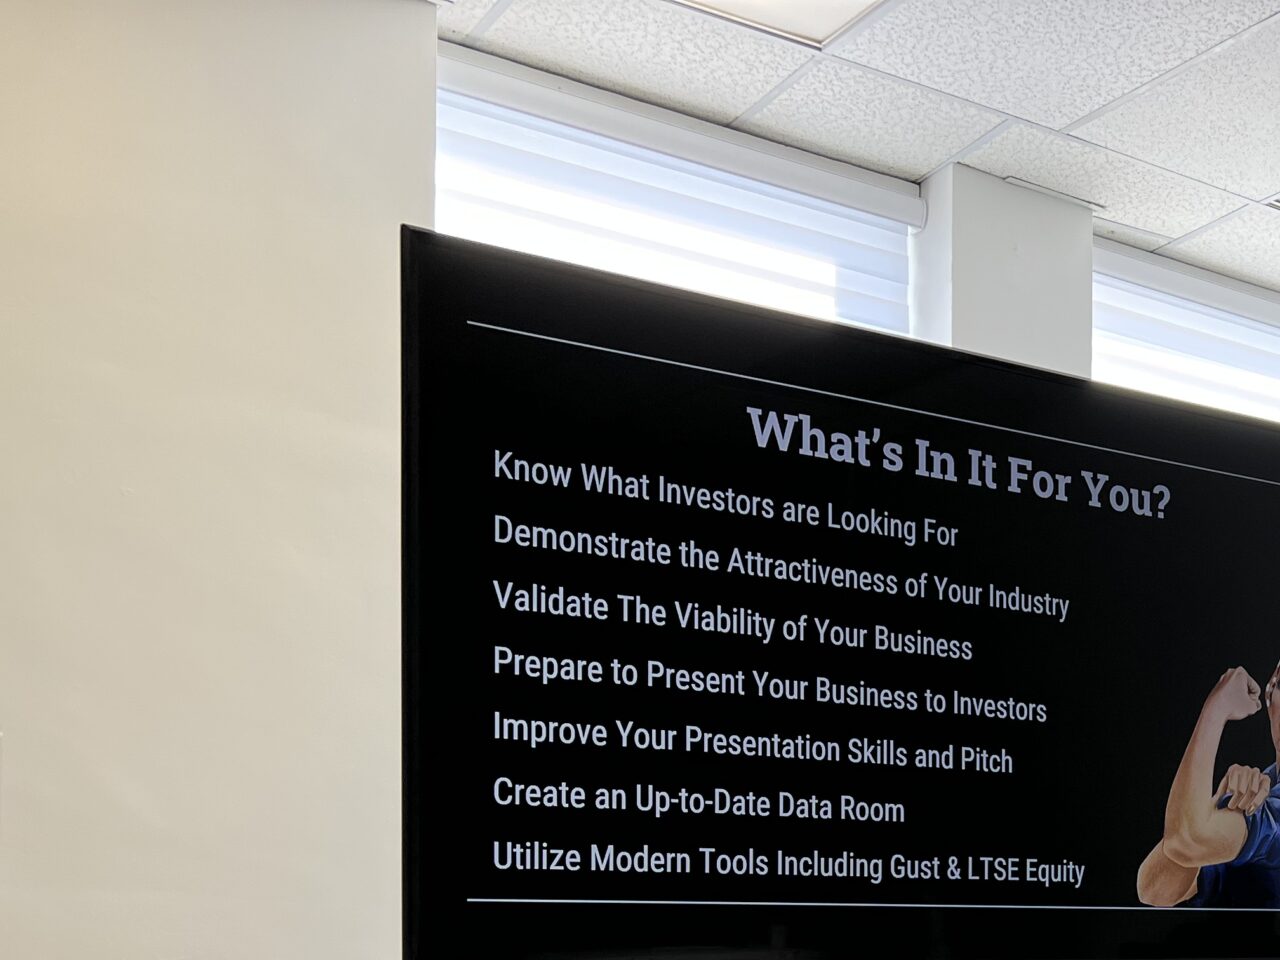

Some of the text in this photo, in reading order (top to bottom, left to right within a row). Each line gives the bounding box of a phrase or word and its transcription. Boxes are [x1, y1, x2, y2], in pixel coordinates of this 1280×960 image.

[495, 450, 958, 546] Know What Investors are Looking For
[746, 406, 1170, 519] What's In It For You?
[495, 515, 1070, 623] Demonstrate the Attractiveness of Your Industry
[493, 580, 973, 660] Validate The Viability of Your Business
[495, 645, 1047, 722] Prepare to Present Your Business to Investors
[495, 711, 1013, 773] Improve Your Presentation Skills and Pitch
[494, 777, 904, 822] Create an Up-to-Date Data Room
[494, 841, 1085, 889] Utilize Modern Tools Including Gust & LTSE Equity
